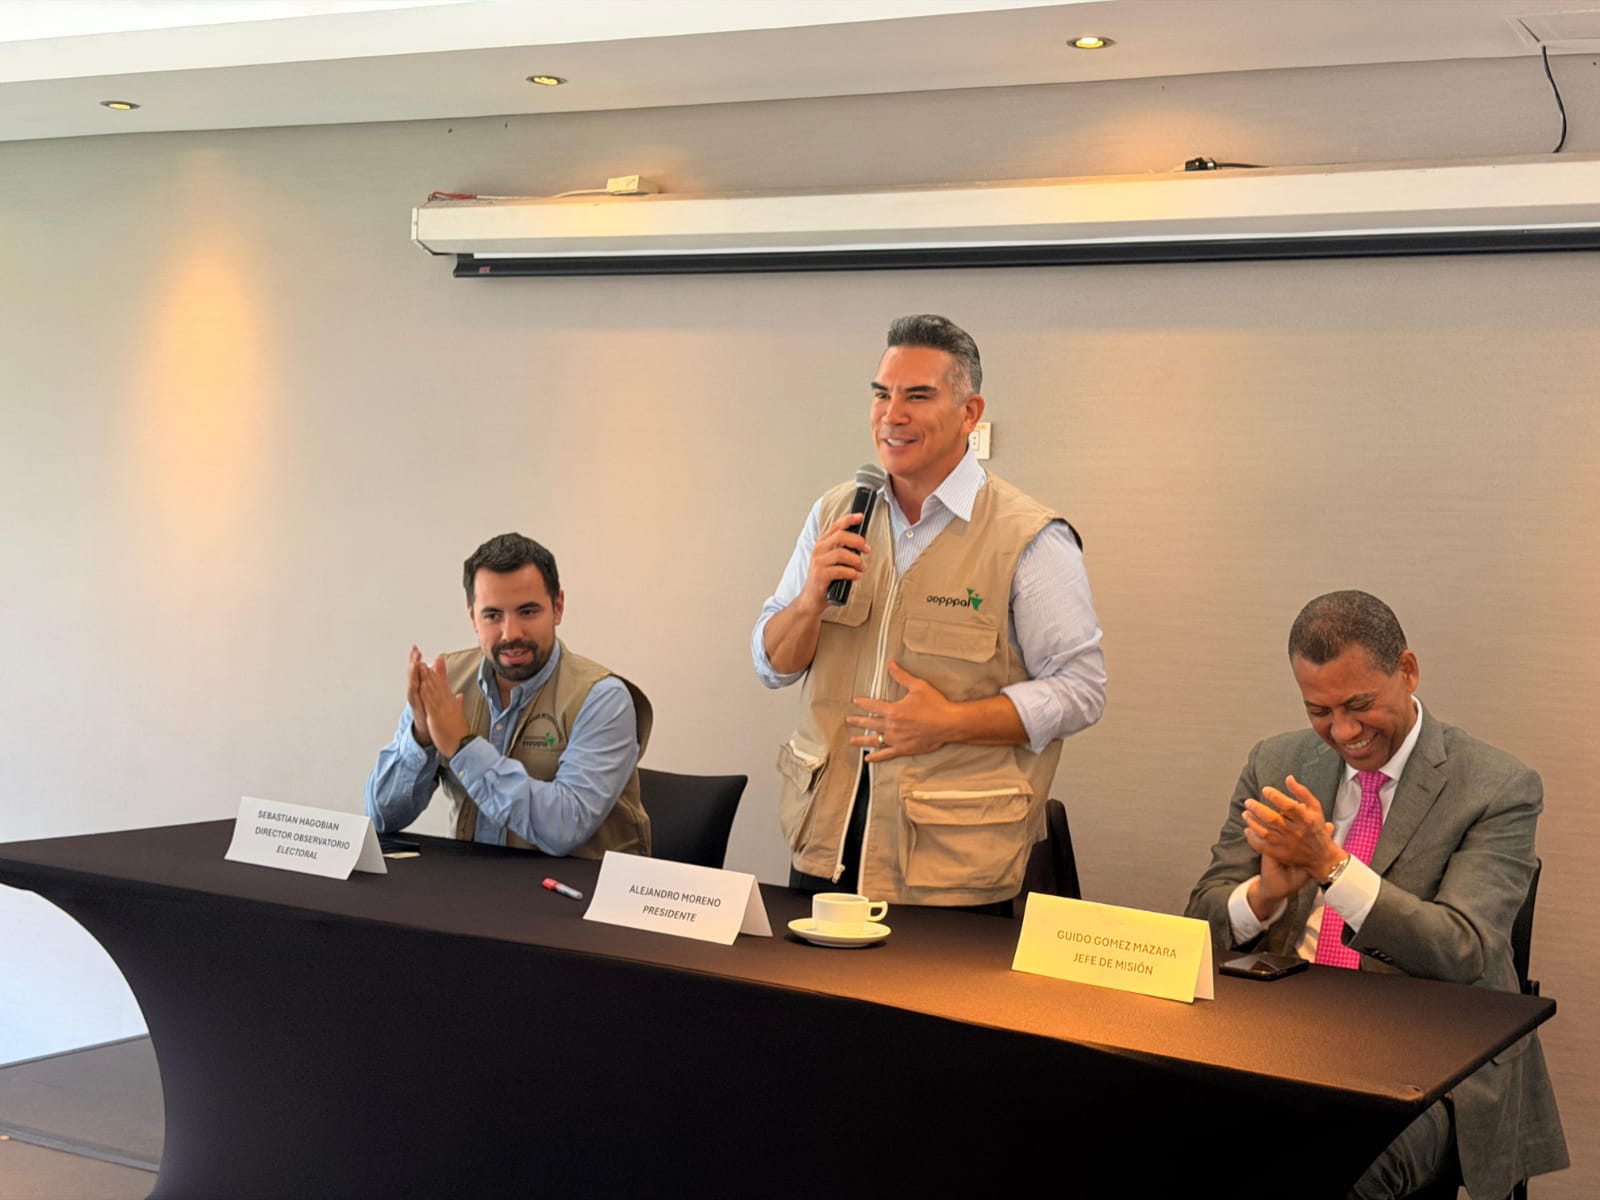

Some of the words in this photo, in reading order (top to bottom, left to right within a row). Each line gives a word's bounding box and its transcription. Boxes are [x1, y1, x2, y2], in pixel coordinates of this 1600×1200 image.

[257, 810, 298, 824] SEBASTIAN
[299, 817, 340, 831] HAGOBIAN
[254, 826, 293, 841] DIRECTOR
[293, 832, 350, 850] OBSERVATORIO
[276, 845, 318, 860] ELECTORAL
[629, 884, 680, 901] ALEJANDRO
[680, 892, 721, 908] MORENO
[642, 904, 697, 922] PRESIDENTE
[1056, 929, 1092, 944] GUIDO
[1093, 936, 1131, 951] GOMEZ
[1132, 942, 1177, 959] MAZARA
[1073, 952, 1097, 966] JEFE
[1098, 957, 1113, 968] DE
[1114, 960, 1154, 976] MISIÓN
